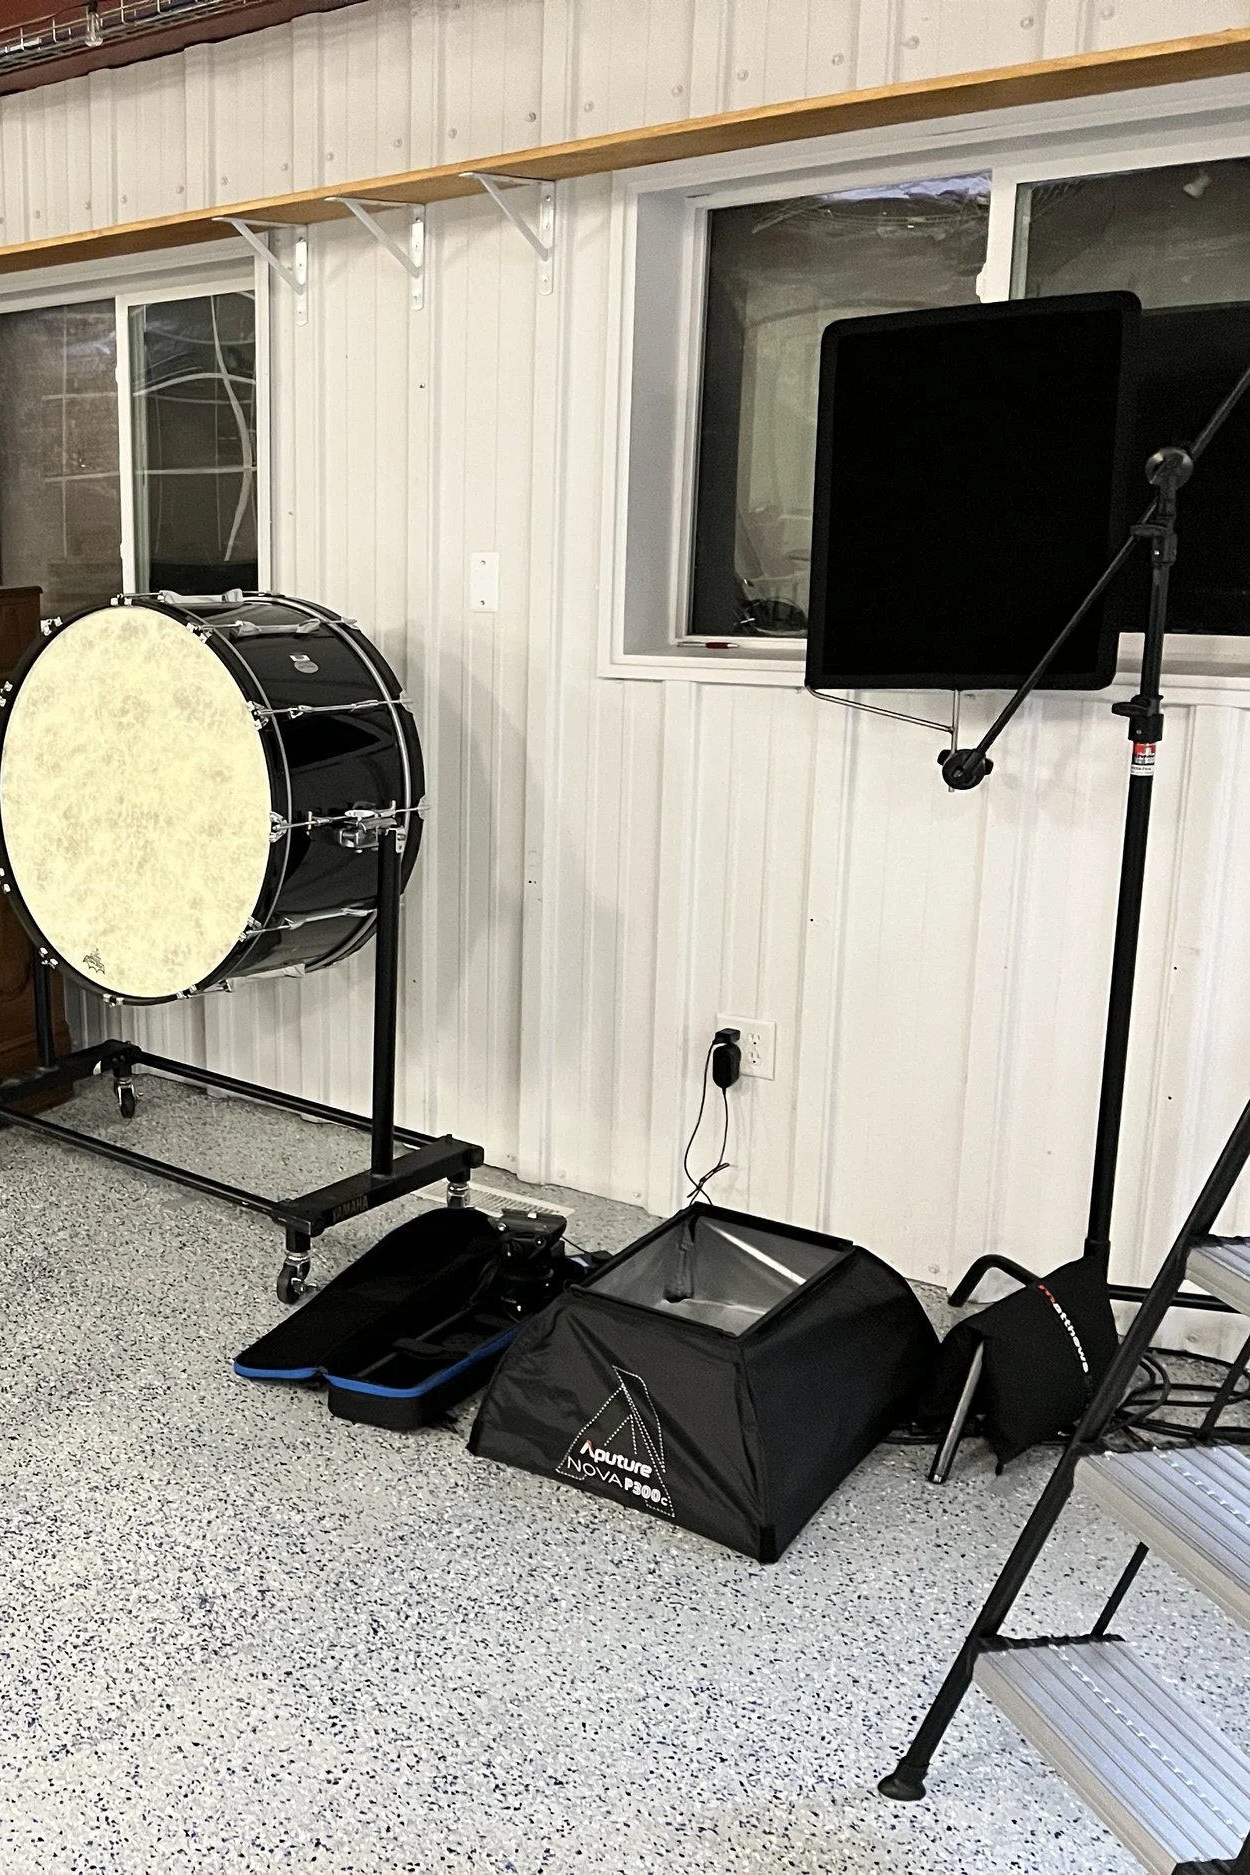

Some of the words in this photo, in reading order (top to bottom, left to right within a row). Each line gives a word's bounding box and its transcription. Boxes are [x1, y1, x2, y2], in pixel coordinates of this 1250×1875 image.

[332, 1194, 369, 1223] YAMAHA
[579, 1439, 653, 1479] Aputure
[567, 1455, 623, 1489] NOVA
[623, 1477, 669, 1507] P300c
